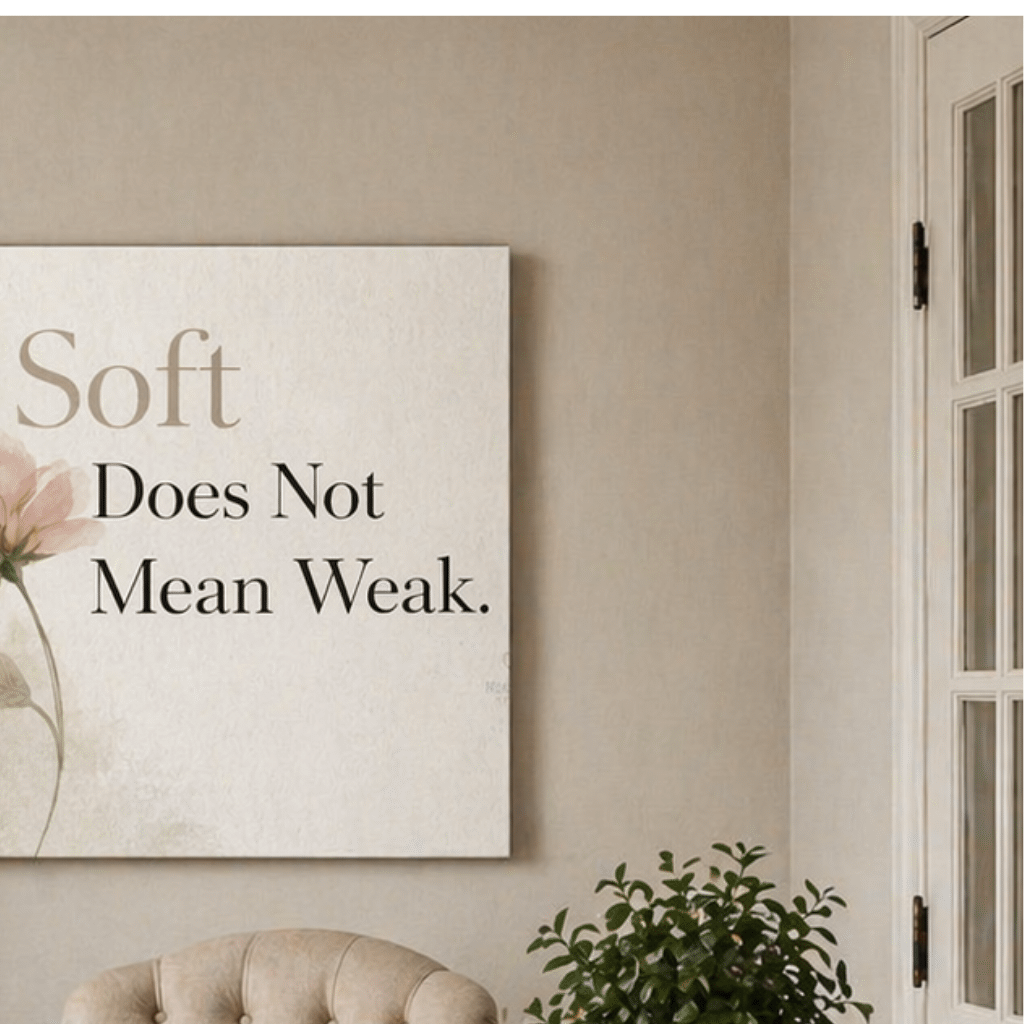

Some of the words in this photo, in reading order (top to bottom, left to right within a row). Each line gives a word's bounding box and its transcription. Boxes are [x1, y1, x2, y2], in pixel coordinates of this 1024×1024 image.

[16, 327, 242, 430] Soft
[92, 462, 250, 520] Does
[271, 462, 386, 520] Not
[90, 557, 274, 615] Mean
[293, 555, 491, 615] Weak.
